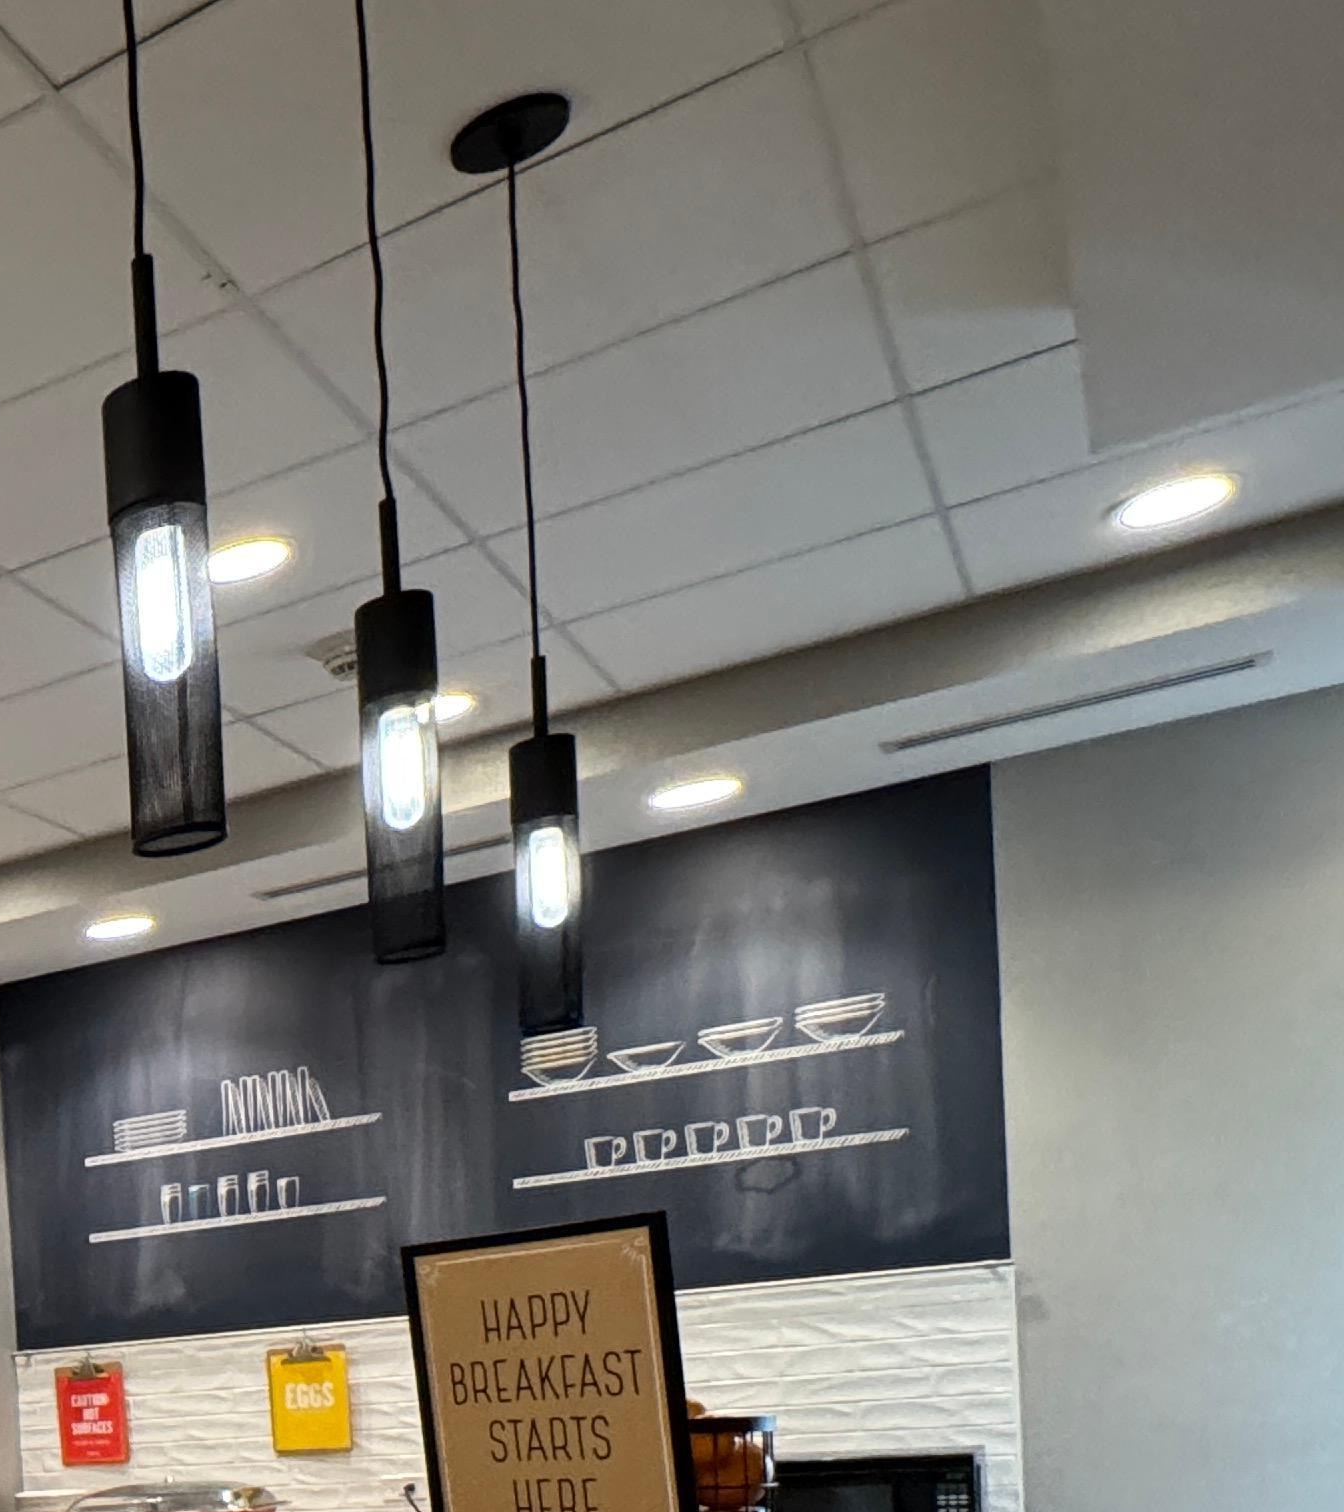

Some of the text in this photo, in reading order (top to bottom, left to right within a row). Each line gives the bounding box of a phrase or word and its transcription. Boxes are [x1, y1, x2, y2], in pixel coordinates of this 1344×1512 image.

[480, 1289, 590, 1343] HAPPY
[284, 1381, 336, 1410] EGGS
[449, 1349, 642, 1405] BREAKFAST
[488, 1415, 612, 1463] STARTS
